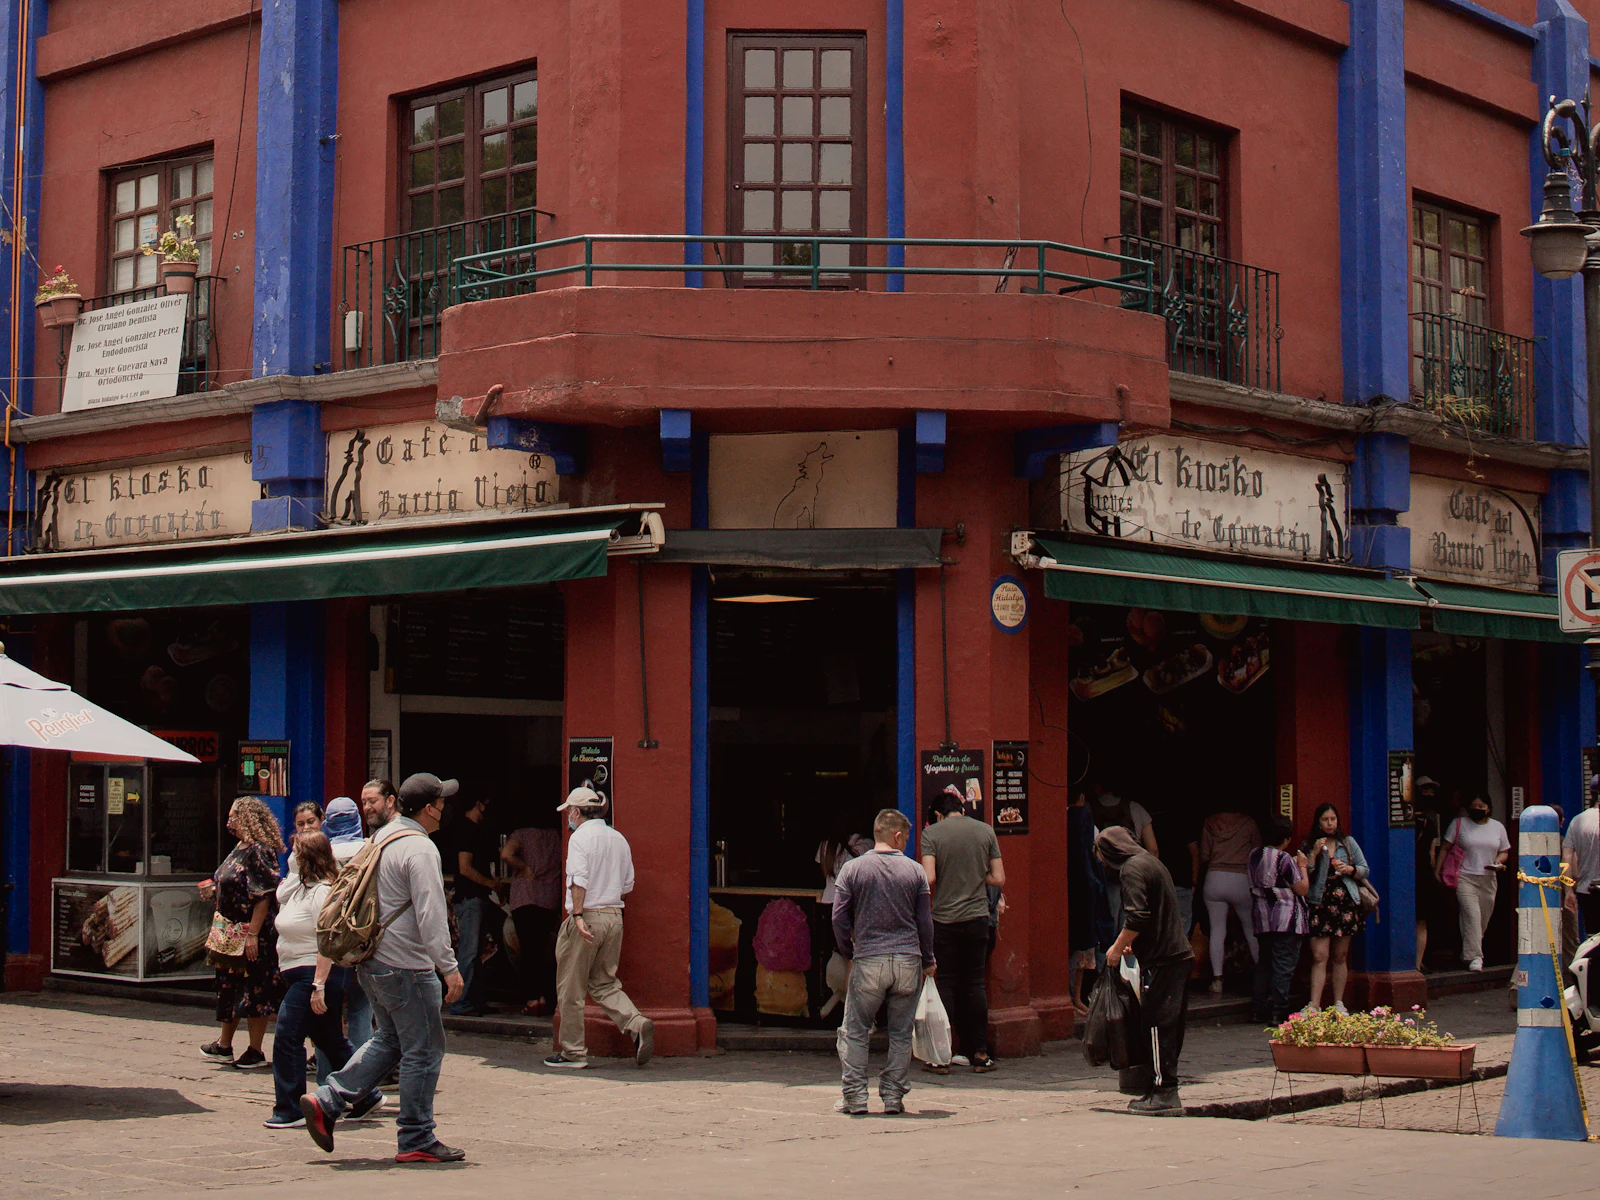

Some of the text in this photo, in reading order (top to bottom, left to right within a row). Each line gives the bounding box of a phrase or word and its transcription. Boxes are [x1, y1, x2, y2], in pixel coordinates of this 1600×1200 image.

[160, 298, 183, 309] Oliver
[97, 313, 157, 332] Cirujano Dentista
[76, 344, 86, 353] Dr.
[102, 342, 149, 358] Endodoncista
[77, 356, 168, 380] Dra. Mayte Guevara Nava
[97, 372, 144, 387] Ortodoncista
[1130, 441, 1163, 486] El
[64, 475, 95, 504] El
[378, 469, 551, 519] Barrio Viejo
[1492, 508, 1512, 535] del
[1432, 531, 1531, 577] Barrio Viejo
[994, 593, 1024, 602] Hidalgo
[27, 708, 93, 743] Peñafiel
[924, 763, 980, 775] Yoghurt y fruta
[932, 754, 971, 763] Paletas de
[1282, 785, 1290, 815] ALIDA
